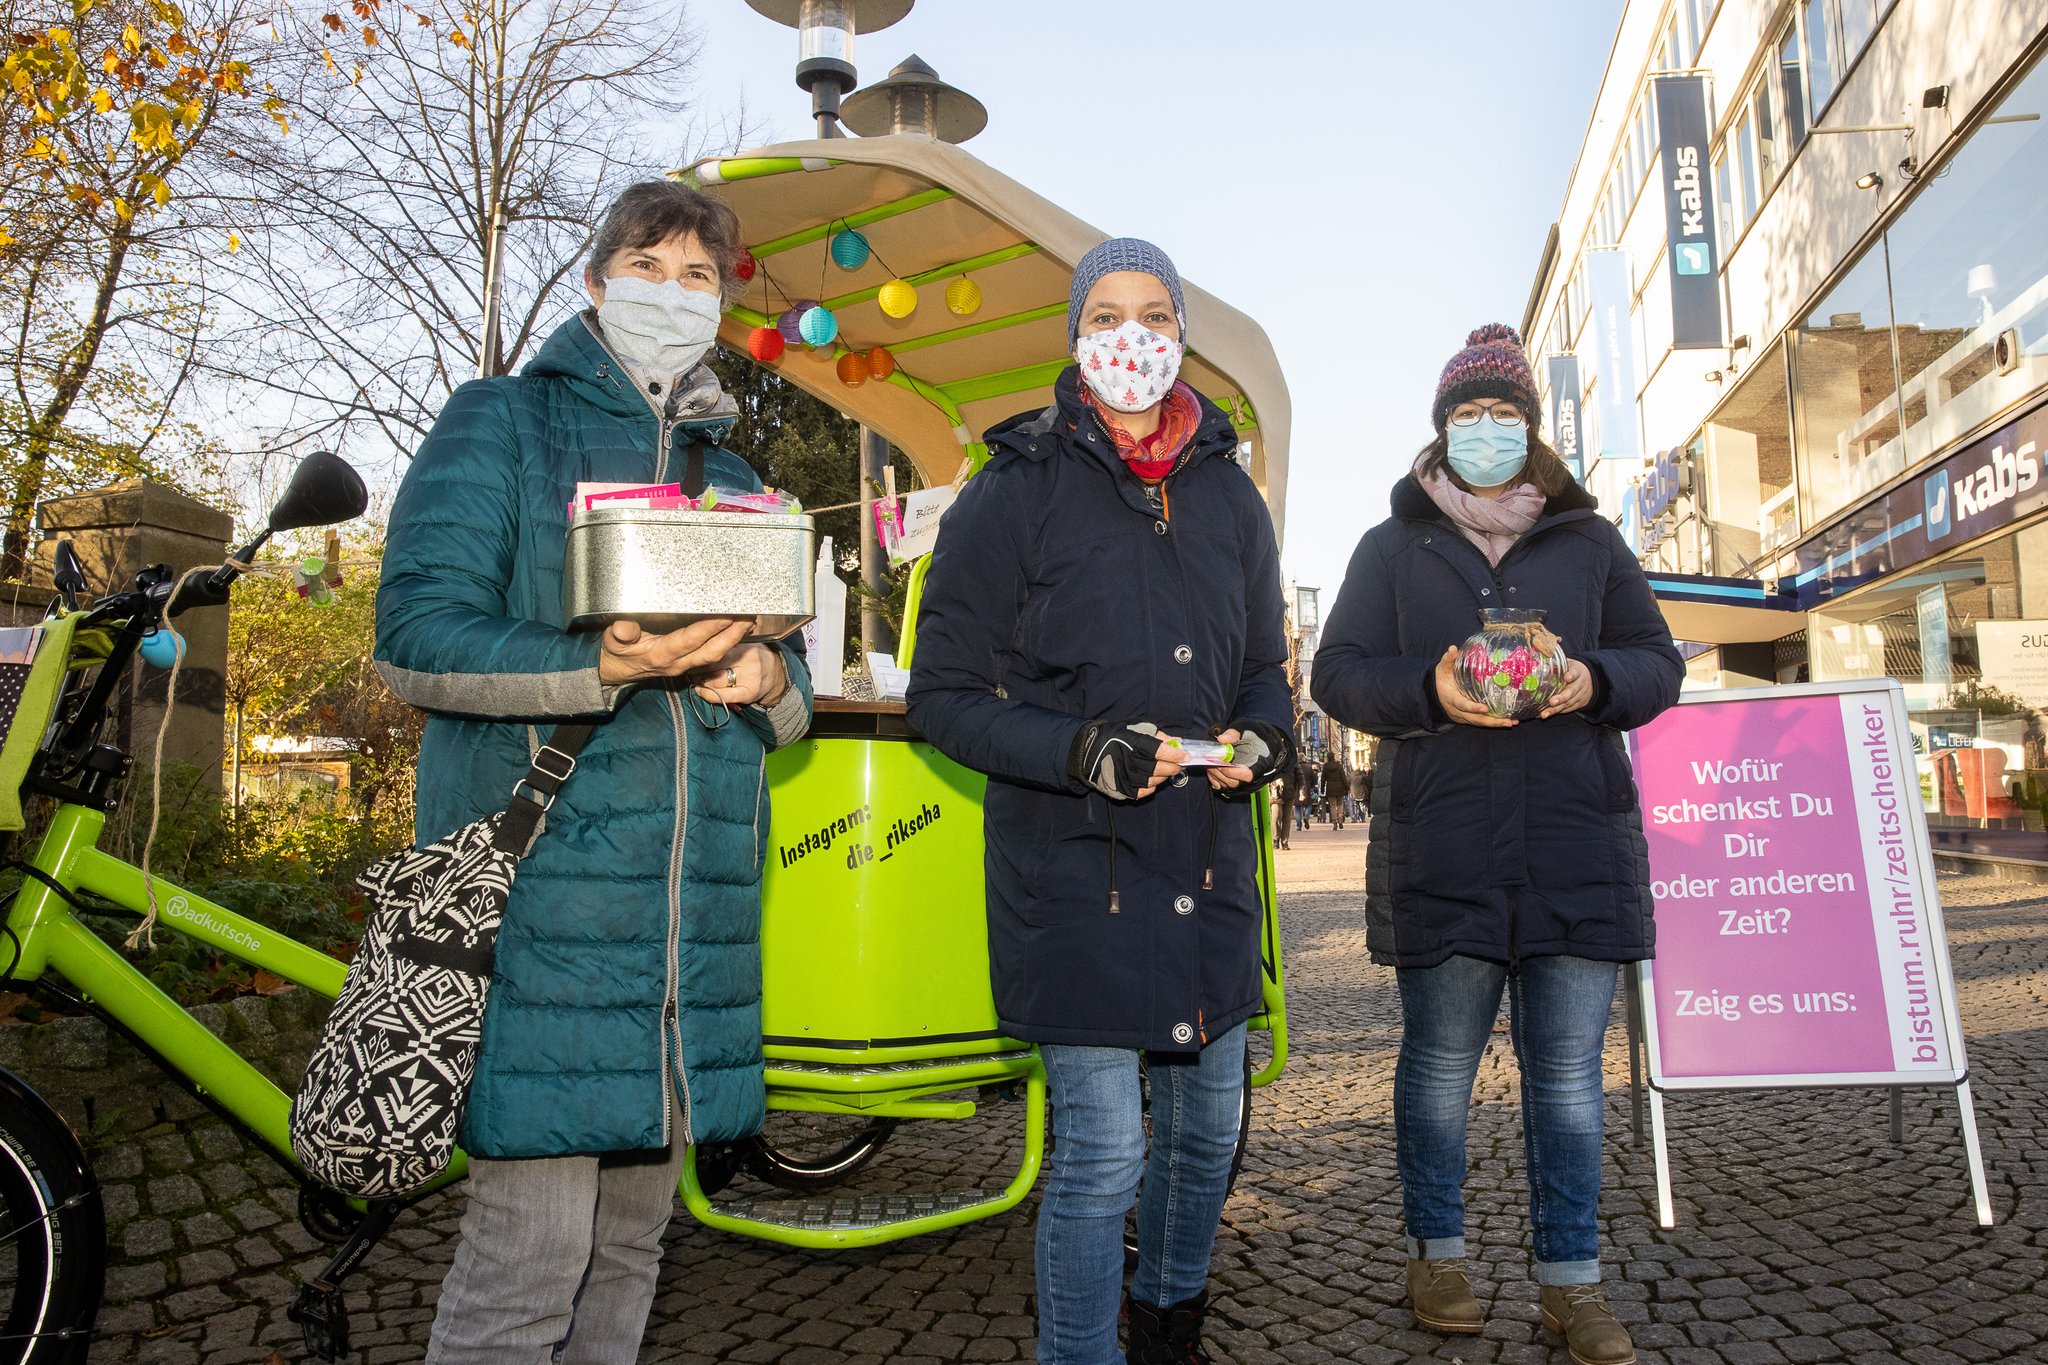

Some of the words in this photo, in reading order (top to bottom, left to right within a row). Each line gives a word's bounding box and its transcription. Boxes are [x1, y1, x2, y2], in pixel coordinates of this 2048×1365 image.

[916, 504, 940, 519] Bitte
[1690, 758, 1783, 785] Wofür
[1652, 794, 1782, 825] schenkst
[1789, 792, 1834, 818] Du
[779, 804, 872, 869] Instagram:
[1723, 833, 1770, 859] Dir
[1650, 875, 1720, 900] oder
[1729, 869, 1855, 896] anderen
[1863, 704, 1938, 1064] bistum.ruhr/zeitschenker
[1718, 908, 1792, 936] Zeit?
[1674, 989, 1741, 1021] Zeig
[1748, 991, 1785, 1015] es
[1792, 990, 1857, 1014] uns:
[0, 1126, 37, 1168] CHWALBE
